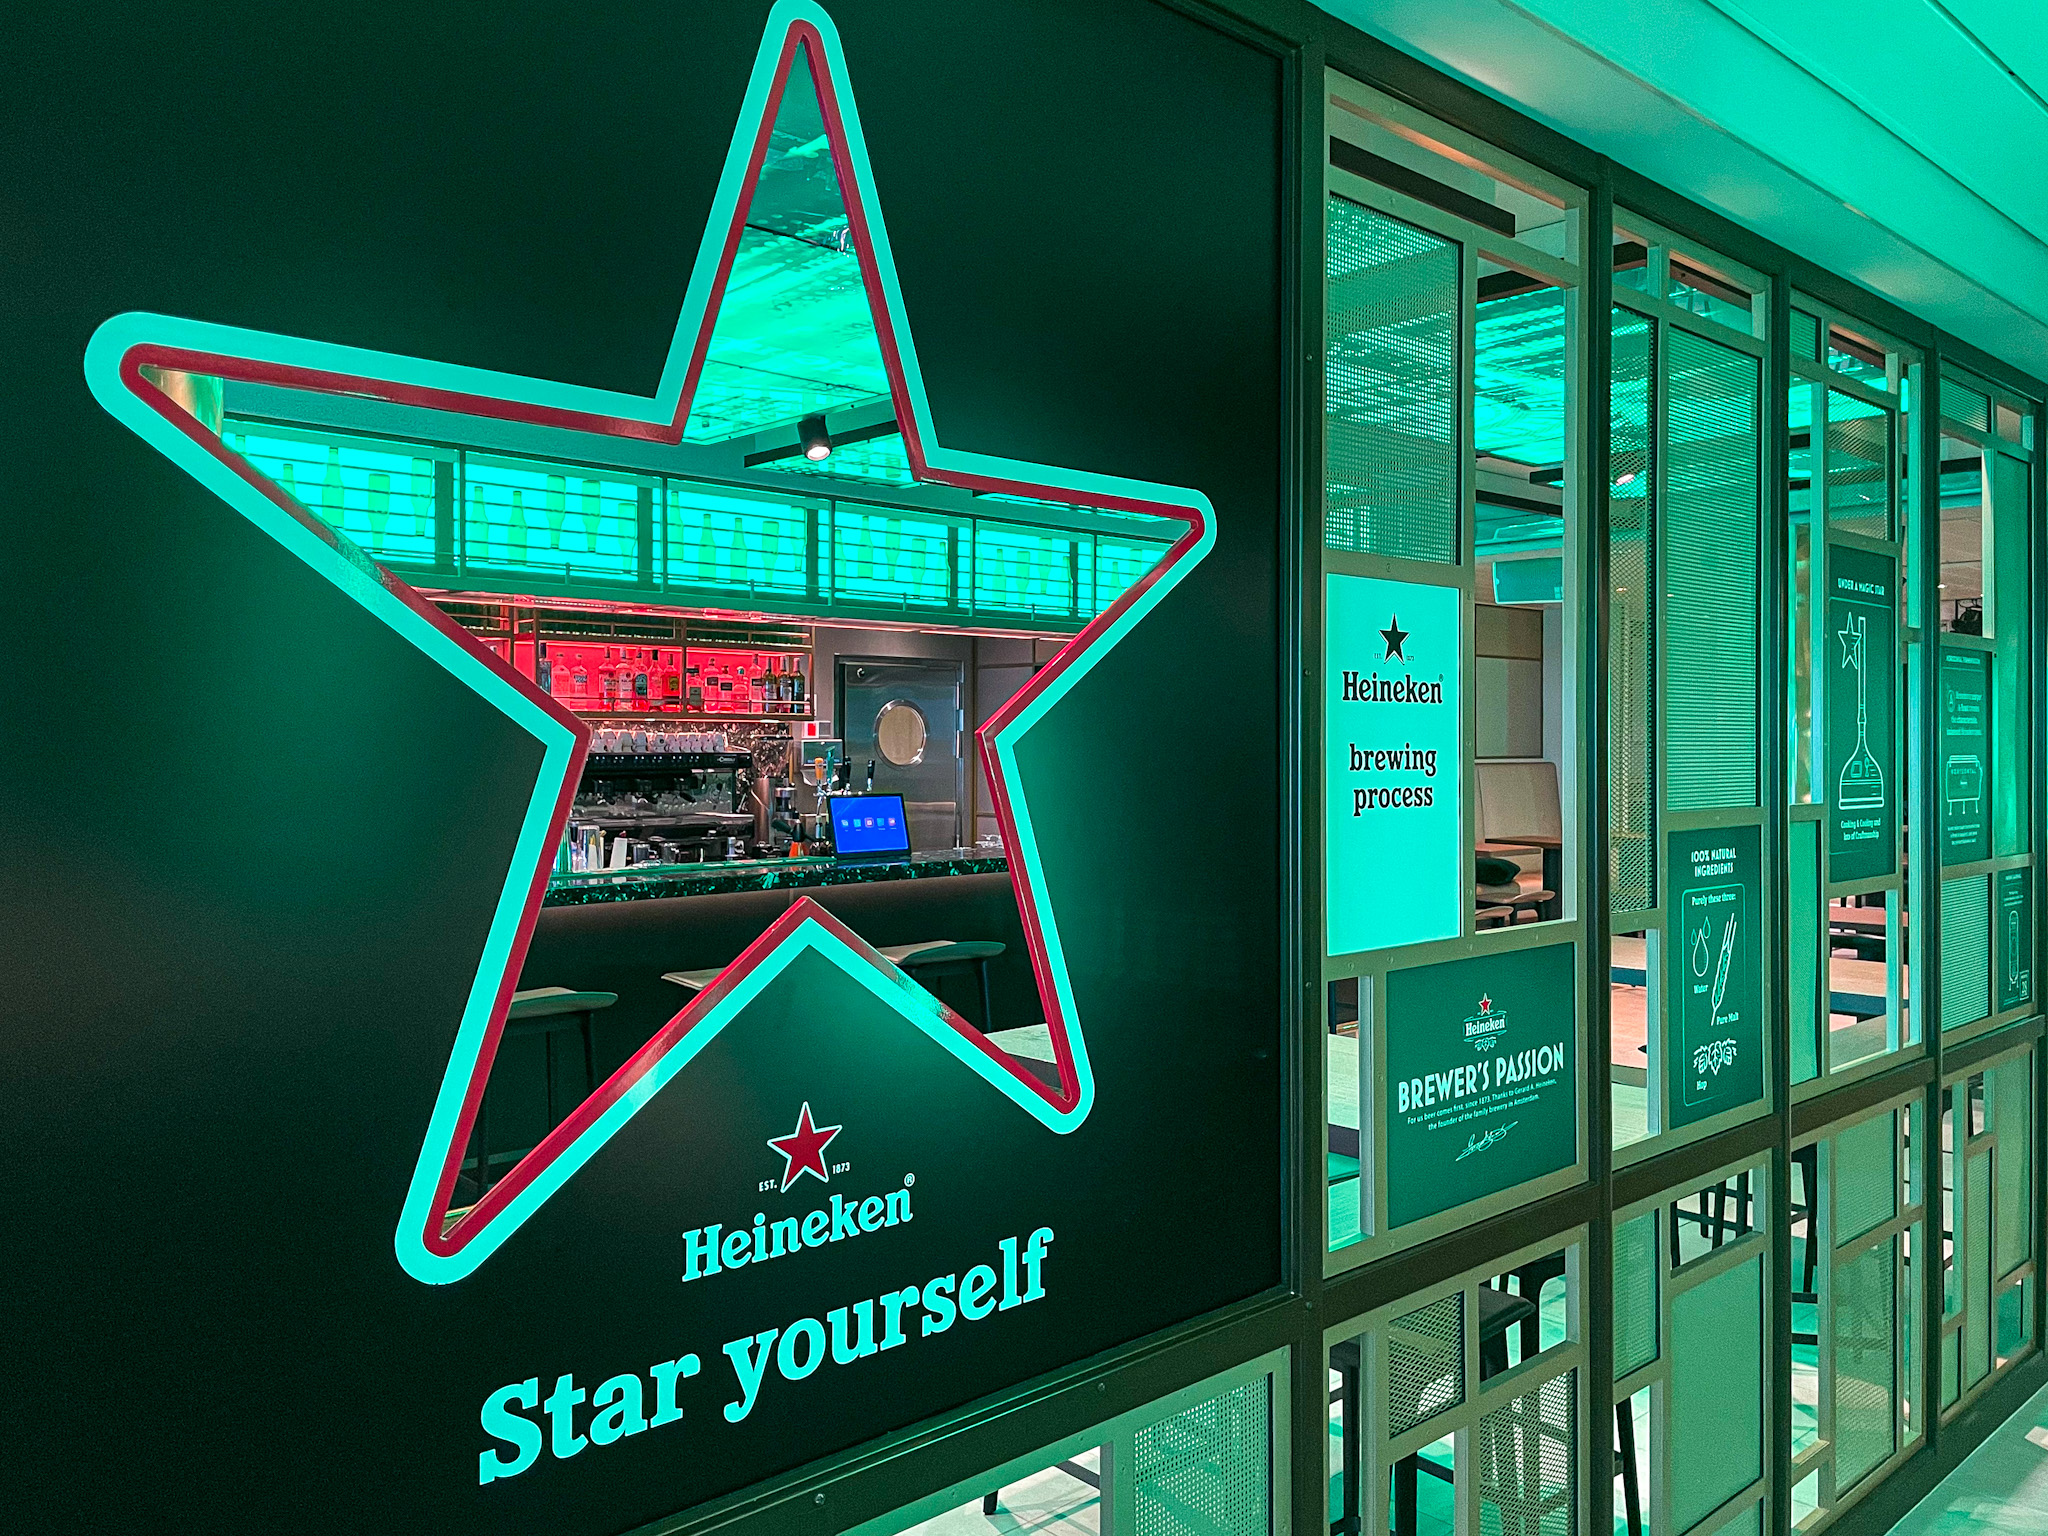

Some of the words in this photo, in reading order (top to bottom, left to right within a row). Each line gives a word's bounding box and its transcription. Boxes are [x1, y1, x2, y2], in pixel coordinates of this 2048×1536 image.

[1349, 742, 1437, 777] brewing
[1353, 787, 1433, 816] process
[1691, 850, 1710, 863] 100%
[1711, 847, 1737, 861] NATURAL
[1694, 862, 1734, 878] INGREDIENTS
[1691, 894, 1708, 906] Purely
[1708, 893, 1722, 903] these
[1693, 984, 1709, 994] Water
[1465, 1017, 1506, 1037] Heineken
[1716, 1015, 1728, 1026] Pure
[1728, 1011, 1740, 1022] Malt
[1398, 1059, 1490, 1114] BREWER'S
[1496, 1042, 1564, 1087] PASSION
[1696, 1080, 1708, 1091] Hop
[1407, 1116, 1417, 1125] For
[1417, 1115, 1424, 1123] us
[1424, 1112, 1436, 1121] beer
[1436, 1107, 1453, 1117] comes
[1465, 1100, 1478, 1109] since
[1491, 1090, 1508, 1101] Thanks
[1514, 1084, 1530, 1095] Gerard
[1428, 1122, 1437, 1131] the
[1437, 1116, 1458, 1129] founder
[1458, 1113, 1464, 1122] of
[1464, 1112, 1473, 1121] the
[1473, 1107, 1489, 1118] family
[1488, 1103, 1508, 1114] brewery
[1508, 1100, 1514, 1108] in
[758, 1179, 778, 1192] EST.
[832, 1161, 851, 1175] 1873
[479, 1353, 701, 1485] Star
[722, 1226, 1055, 1424] yourself
